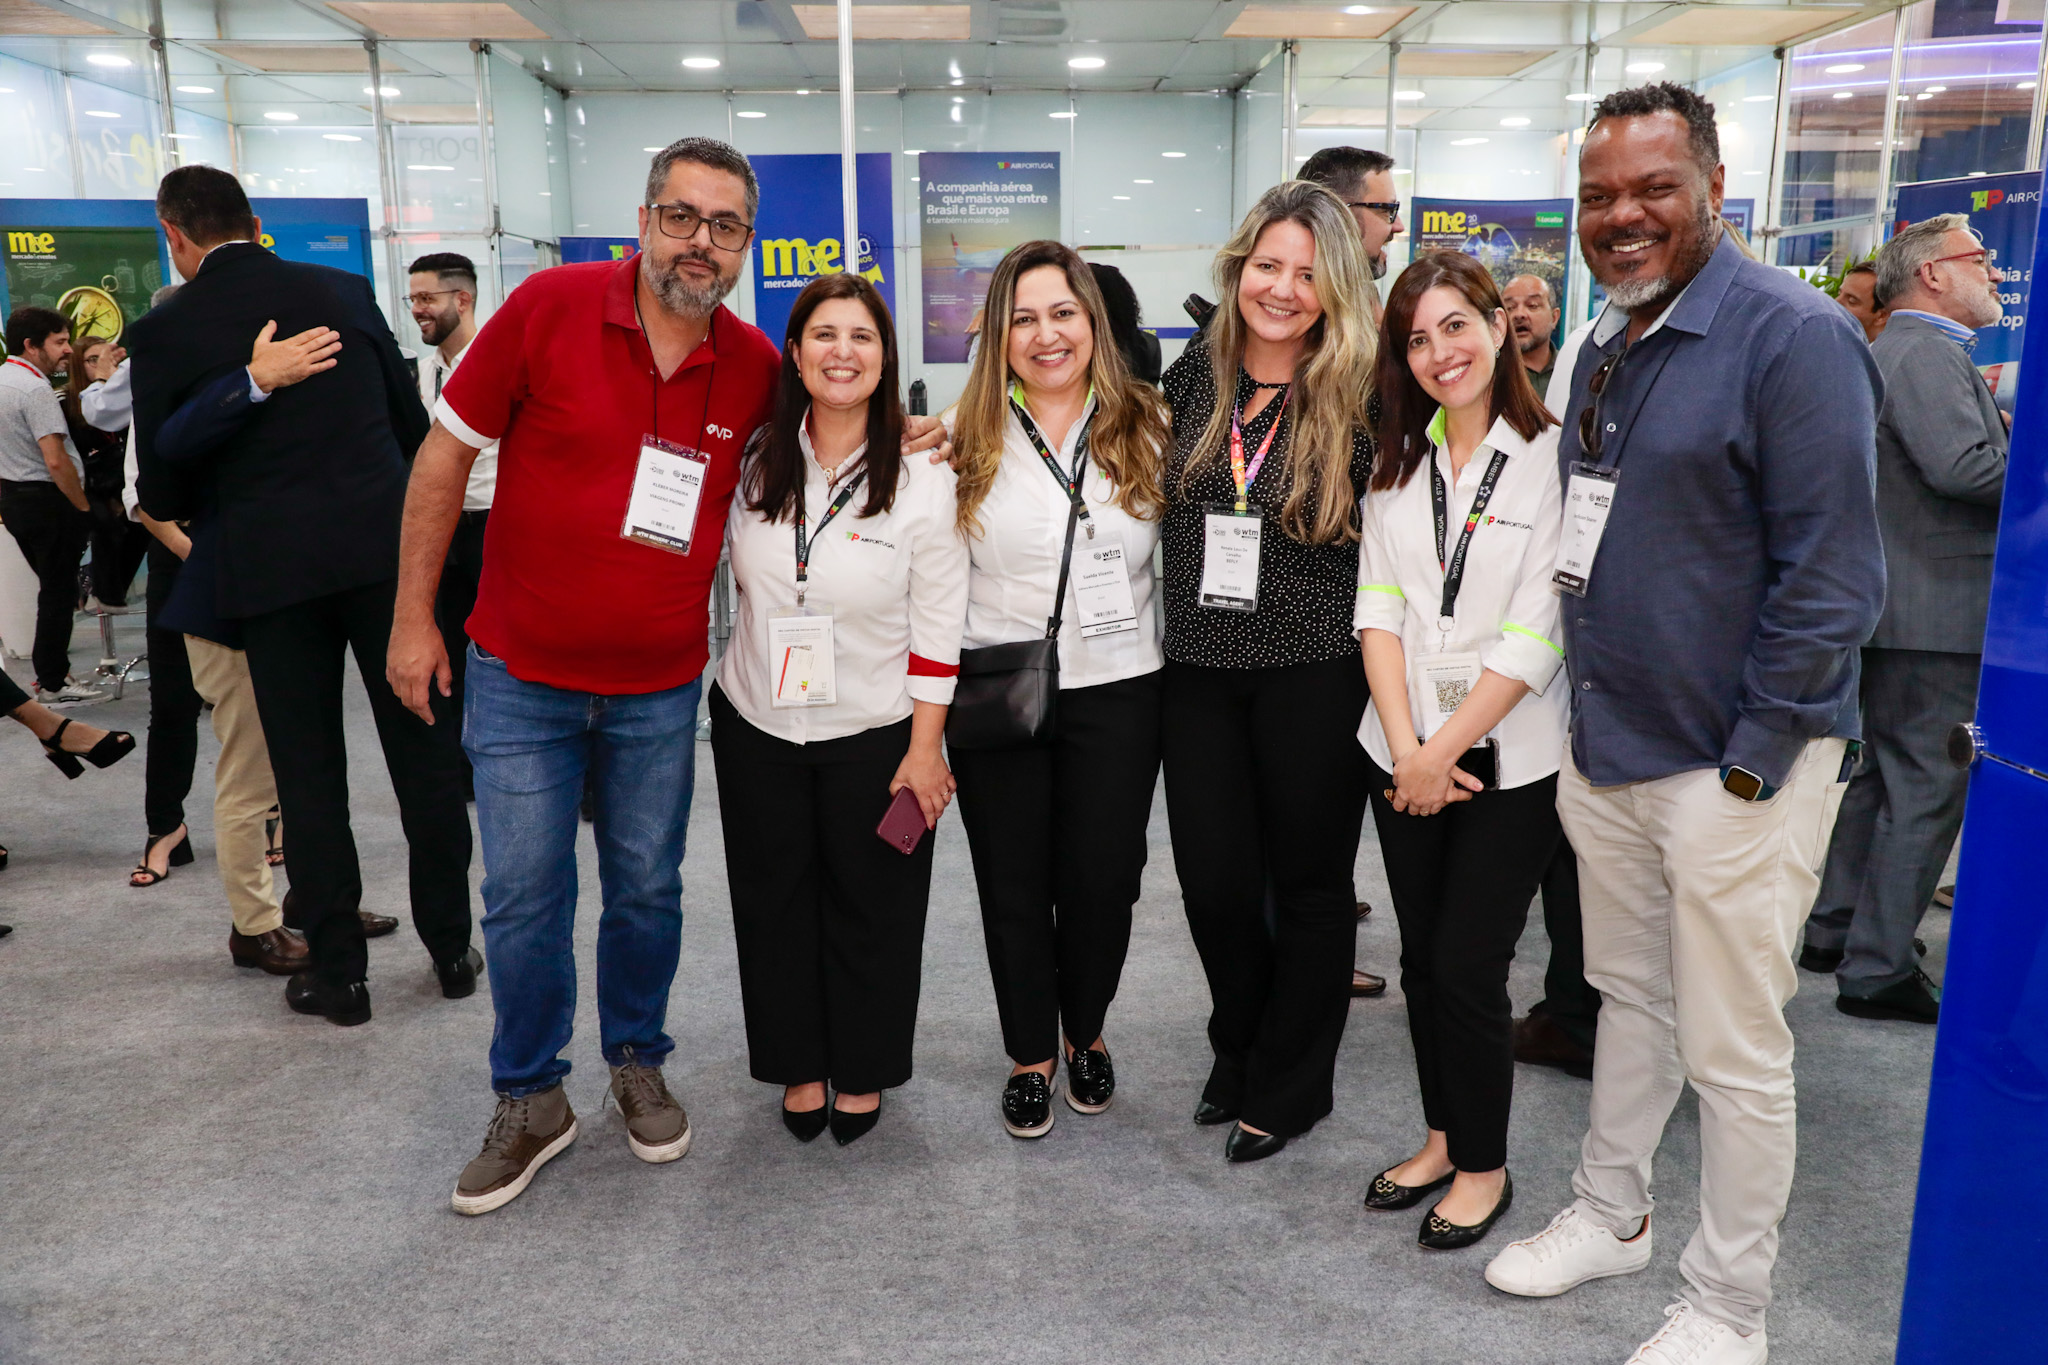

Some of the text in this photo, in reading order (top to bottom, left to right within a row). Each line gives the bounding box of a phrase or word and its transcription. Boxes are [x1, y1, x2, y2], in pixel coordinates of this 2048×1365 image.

[926, 181, 1033, 195] A companhia aérea
[942, 193, 1048, 205] que mais voa entre
[1970, 189, 2004, 212] TAP
[926, 205, 1010, 217] Brasil e Europa
[1422, 210, 1478, 233] m&e 20
[8, 231, 56, 254] m&e
[608, 245, 635, 261] TAP
[761, 237, 845, 277] m&e
[763, 277, 817, 289] mercado&
[681, 472, 700, 484] wtm
[1435, 477, 1443, 496] STAR
[1596, 493, 1610, 503] wtm
[1466, 512, 1481, 532] TAP
[1242, 528, 1259, 536] wtm
[1102, 548, 1121, 558] wtm
[1096, 624, 1122, 633] EXHIBITOR
